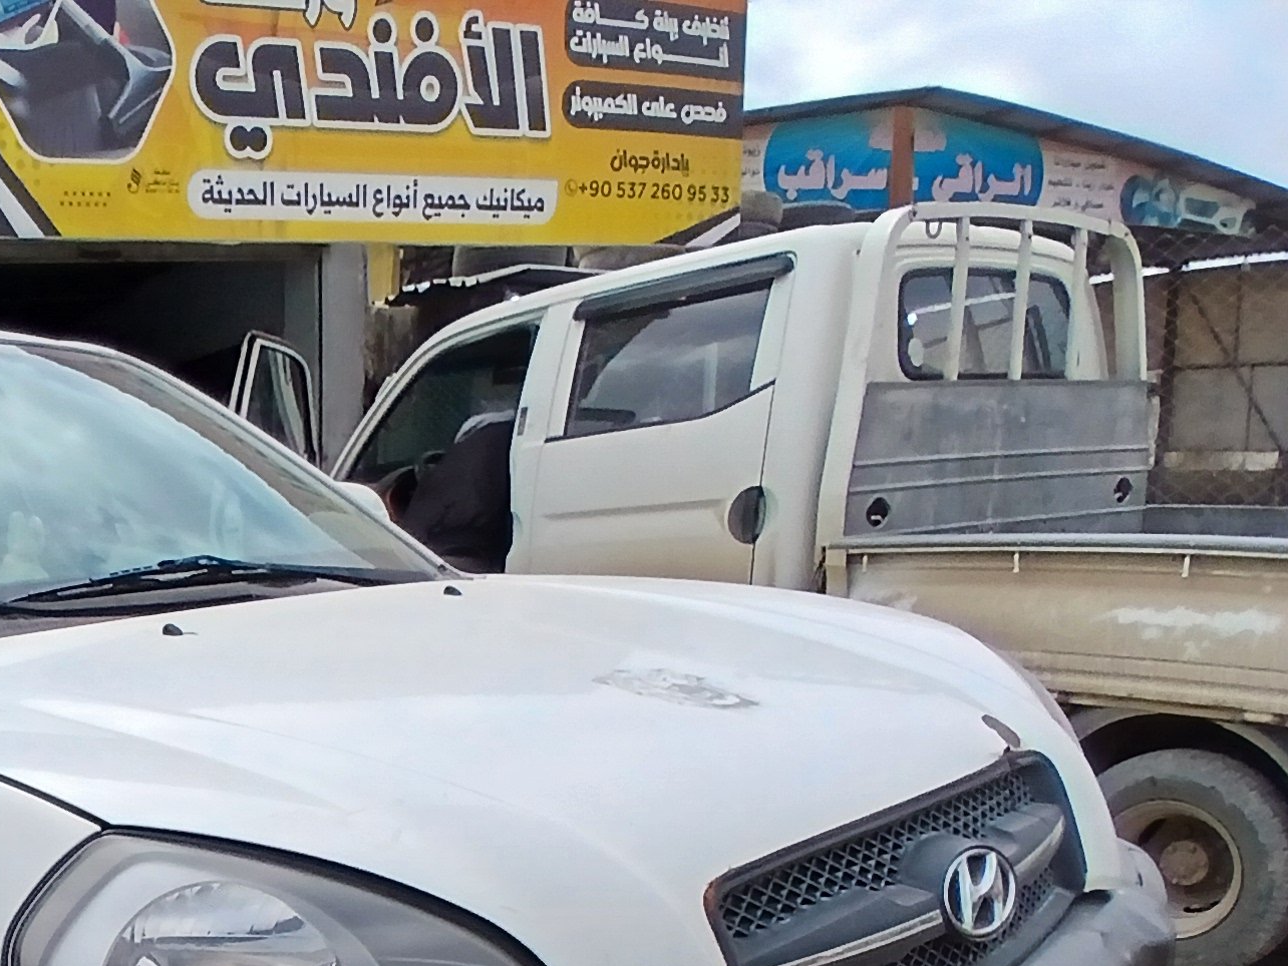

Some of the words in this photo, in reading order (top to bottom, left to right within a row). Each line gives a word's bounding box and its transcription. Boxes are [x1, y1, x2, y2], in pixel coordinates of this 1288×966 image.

[570, 30, 630, 64] السيارات
[192, 11, 550, 159] الأفندي
[570, 86, 638, 121] الكمبيوتر
[681, 101, 727, 125] فحص
[201, 174, 275, 213] الحديثة
[280, 182, 367, 215] السيارات
[372, 179, 418, 218] أنواع
[422, 193, 471, 221] جميع
[476, 188, 544, 219] ميكانيك
[579, 180, 612, 197] +90
[616, 181, 647, 199] 537
[651, 183, 682, 200] 260
[687, 184, 706, 201] 95
[710, 186, 729, 203] 33
